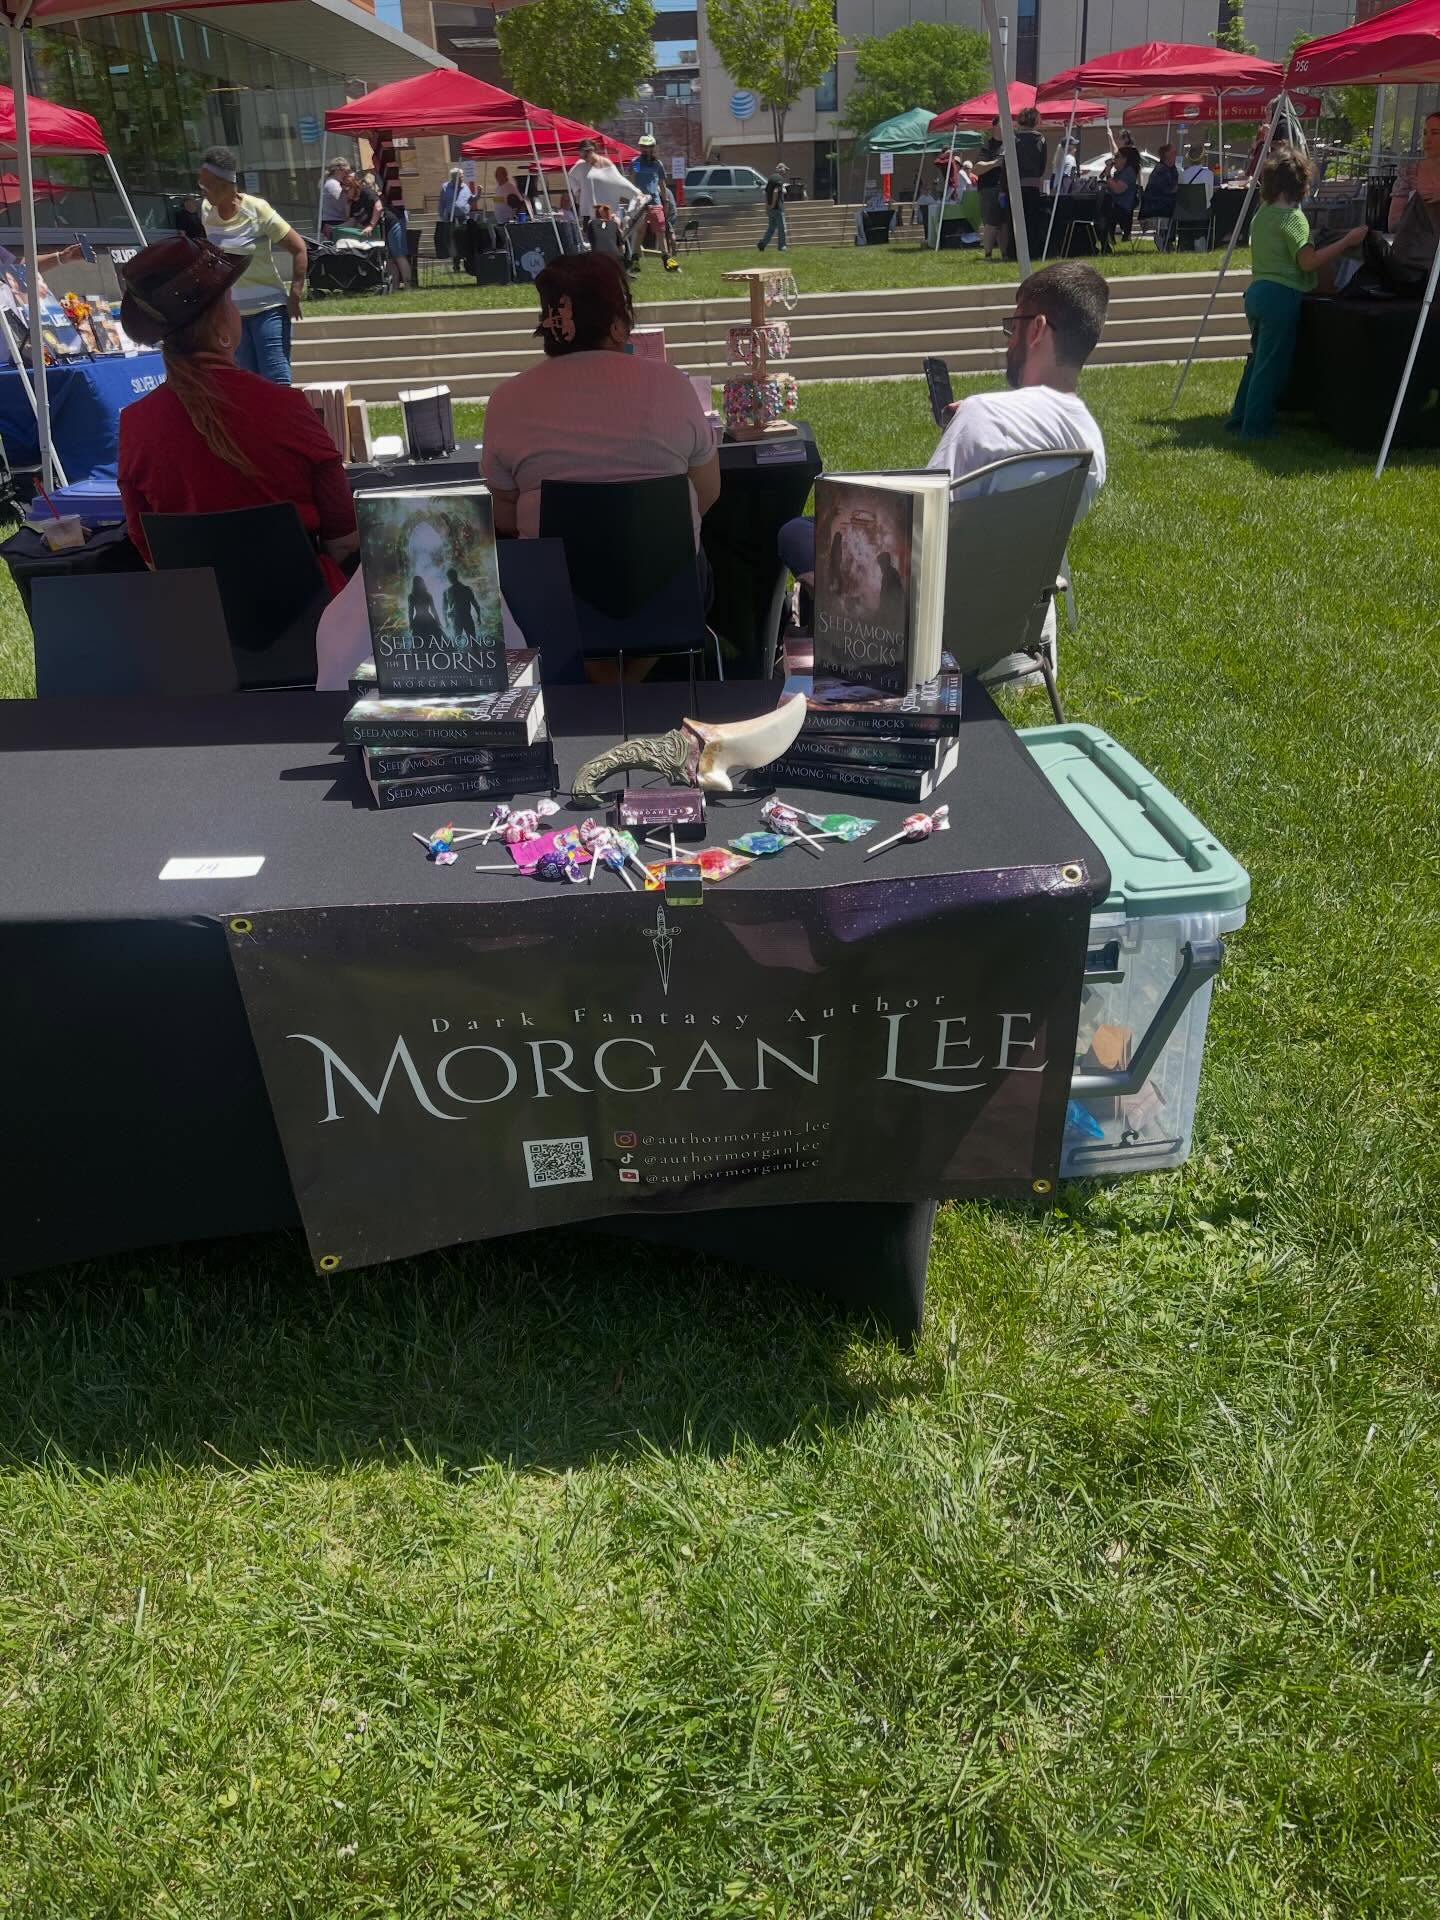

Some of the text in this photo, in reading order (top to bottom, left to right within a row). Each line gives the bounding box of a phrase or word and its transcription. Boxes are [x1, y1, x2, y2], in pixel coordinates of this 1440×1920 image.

[1208, 106, 1230, 117] FRE
[818, 611, 905, 647] SEED AMONG
[379, 633, 496, 657] SEED AMONG
[843, 636, 897, 668] ROCKS
[395, 651, 497, 673] THORNS
[392, 679, 459, 690] MORGAN
[470, 677, 495, 687] LEE
[353, 726, 379, 741] SEED
[380, 728, 419, 739] AMONG
[425, 729, 468, 740] THORNS
[812, 717, 856, 728] AMONG
[872, 718, 905, 729] ROCKS
[794, 742, 836, 754] AMONG
[378, 760, 403, 774] SEED
[405, 757, 446, 770] AMONG
[785, 765, 825, 780] AMONG
[839, 773, 871, 786] ROCKS
[386, 788, 413, 802] SEED
[414, 783, 453, 797] AMONG
[431, 996, 945, 1034] Dark Fantasy Author
[285, 1012, 1050, 1124] MORGAN LEE
[642, 1121, 831, 1147] @authormorgan_lee
[644, 1140, 821, 1165] @authormorganlee
[646, 1157, 821, 1184] @authormorganlee
